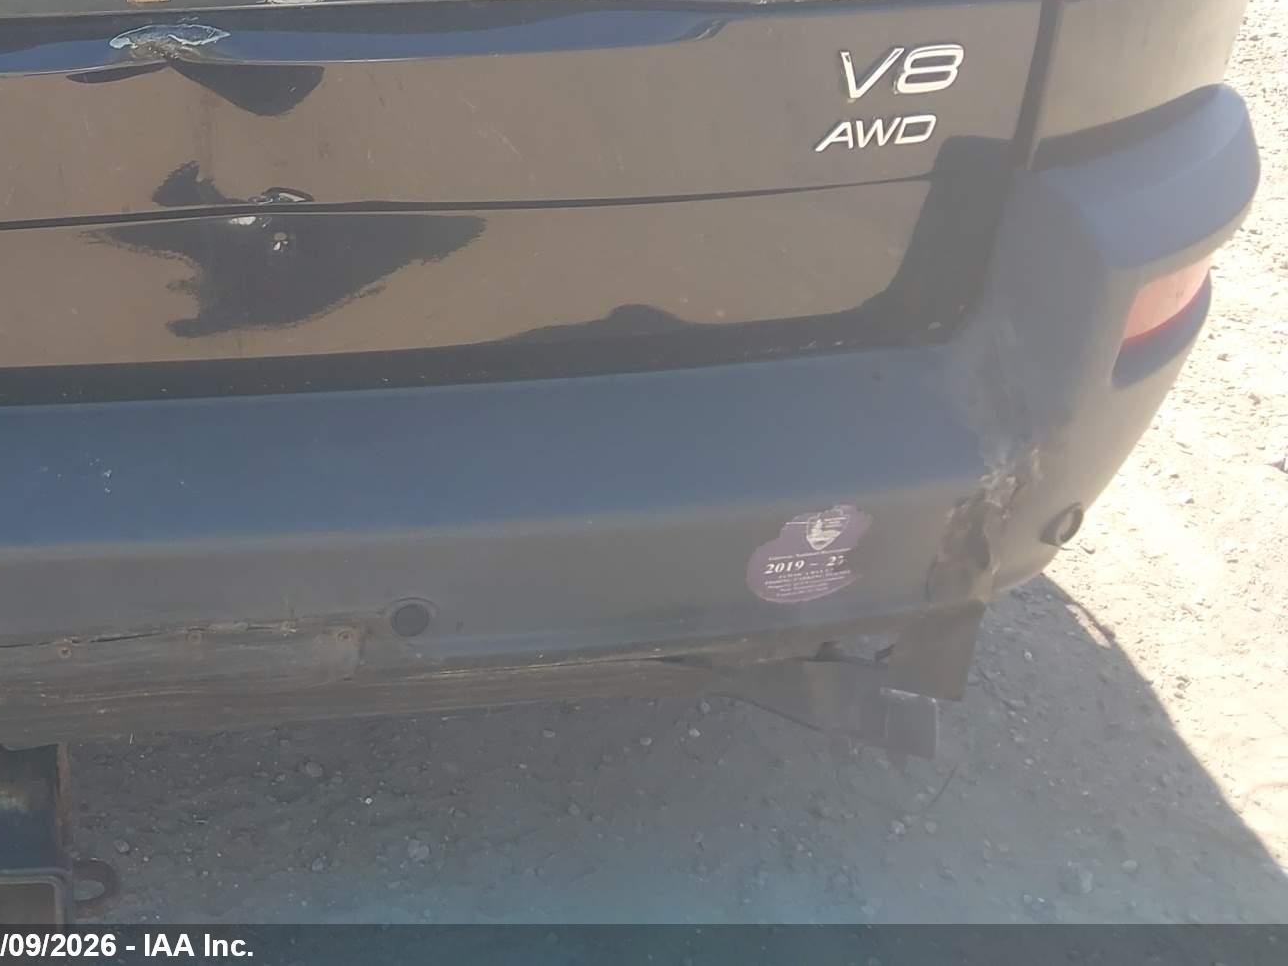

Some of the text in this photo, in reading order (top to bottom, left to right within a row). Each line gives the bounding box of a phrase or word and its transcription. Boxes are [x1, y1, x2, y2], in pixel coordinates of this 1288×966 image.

[840, 44, 965, 99] V8
[815, 114, 937, 152] AWD
[763, 559, 805, 575] 2019
